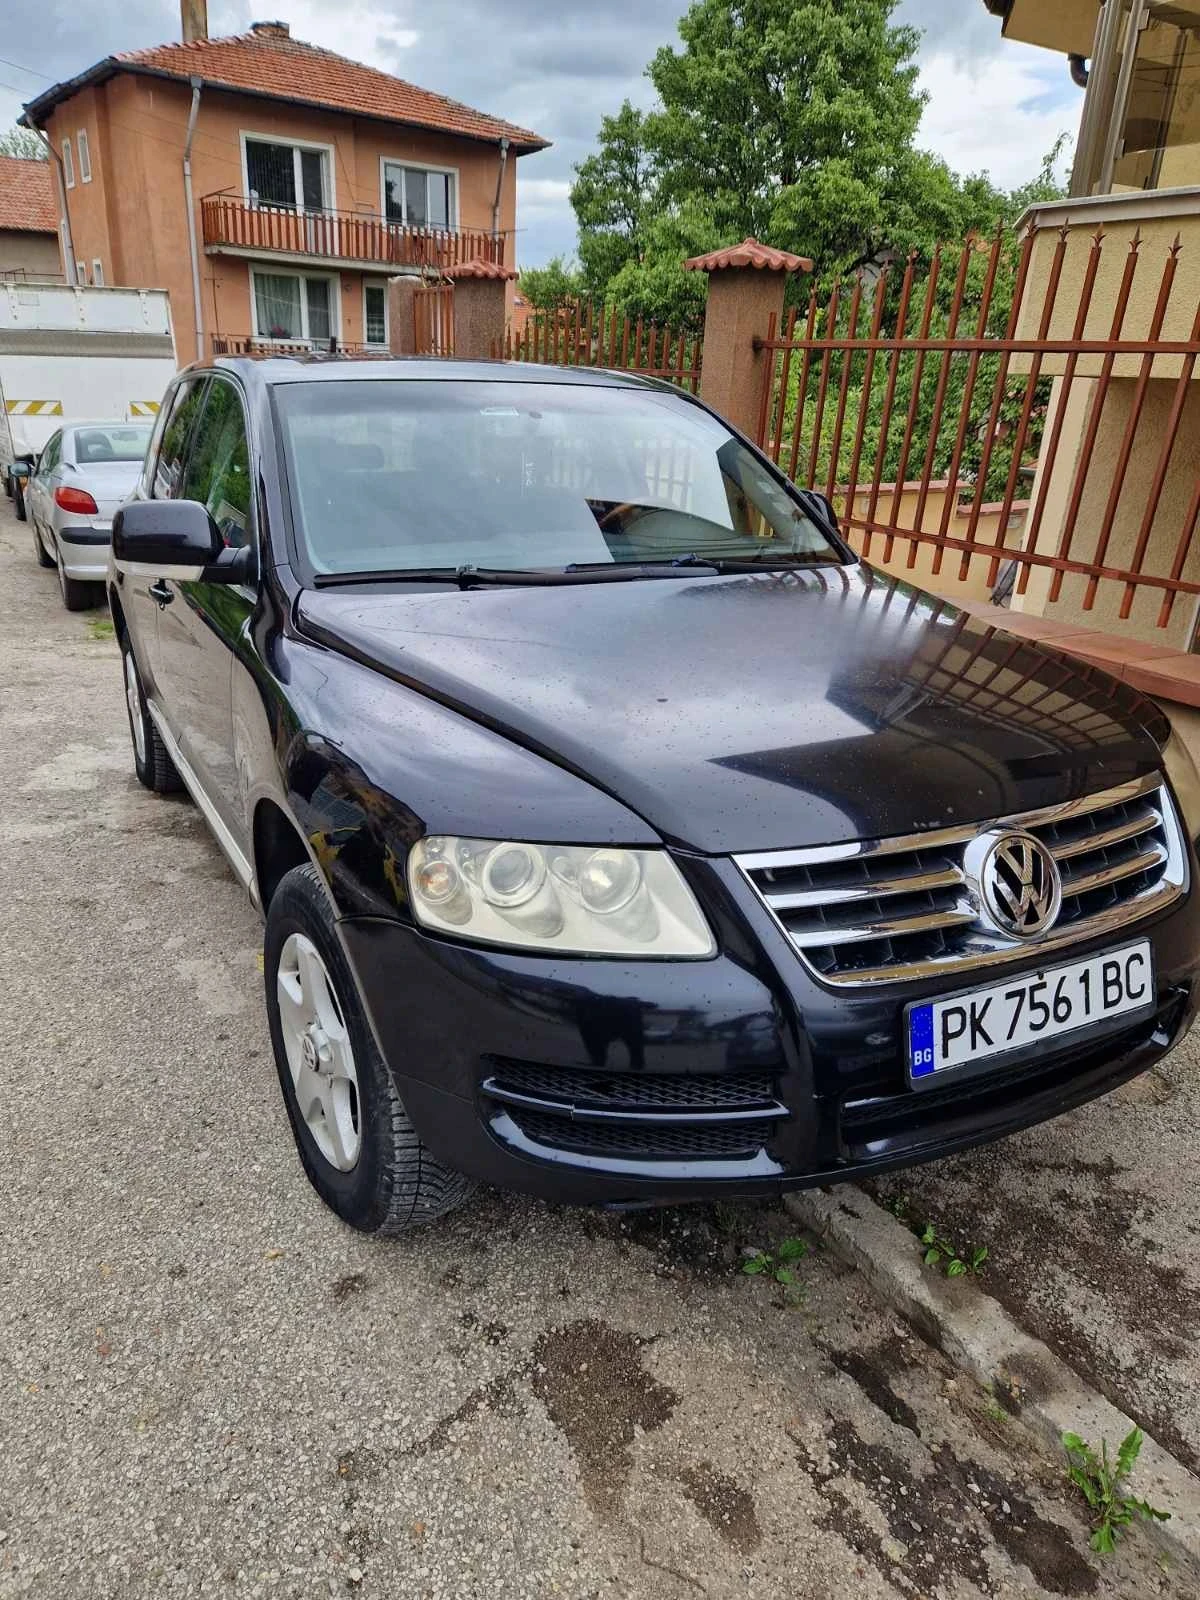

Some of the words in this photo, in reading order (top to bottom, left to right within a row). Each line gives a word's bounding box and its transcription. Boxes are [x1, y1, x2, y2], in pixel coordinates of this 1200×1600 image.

[941, 997, 993, 1059] PK
[1005, 968, 1089, 1041] 7561
[1102, 953, 1145, 1010] BC
[914, 1047, 932, 1066] BG
